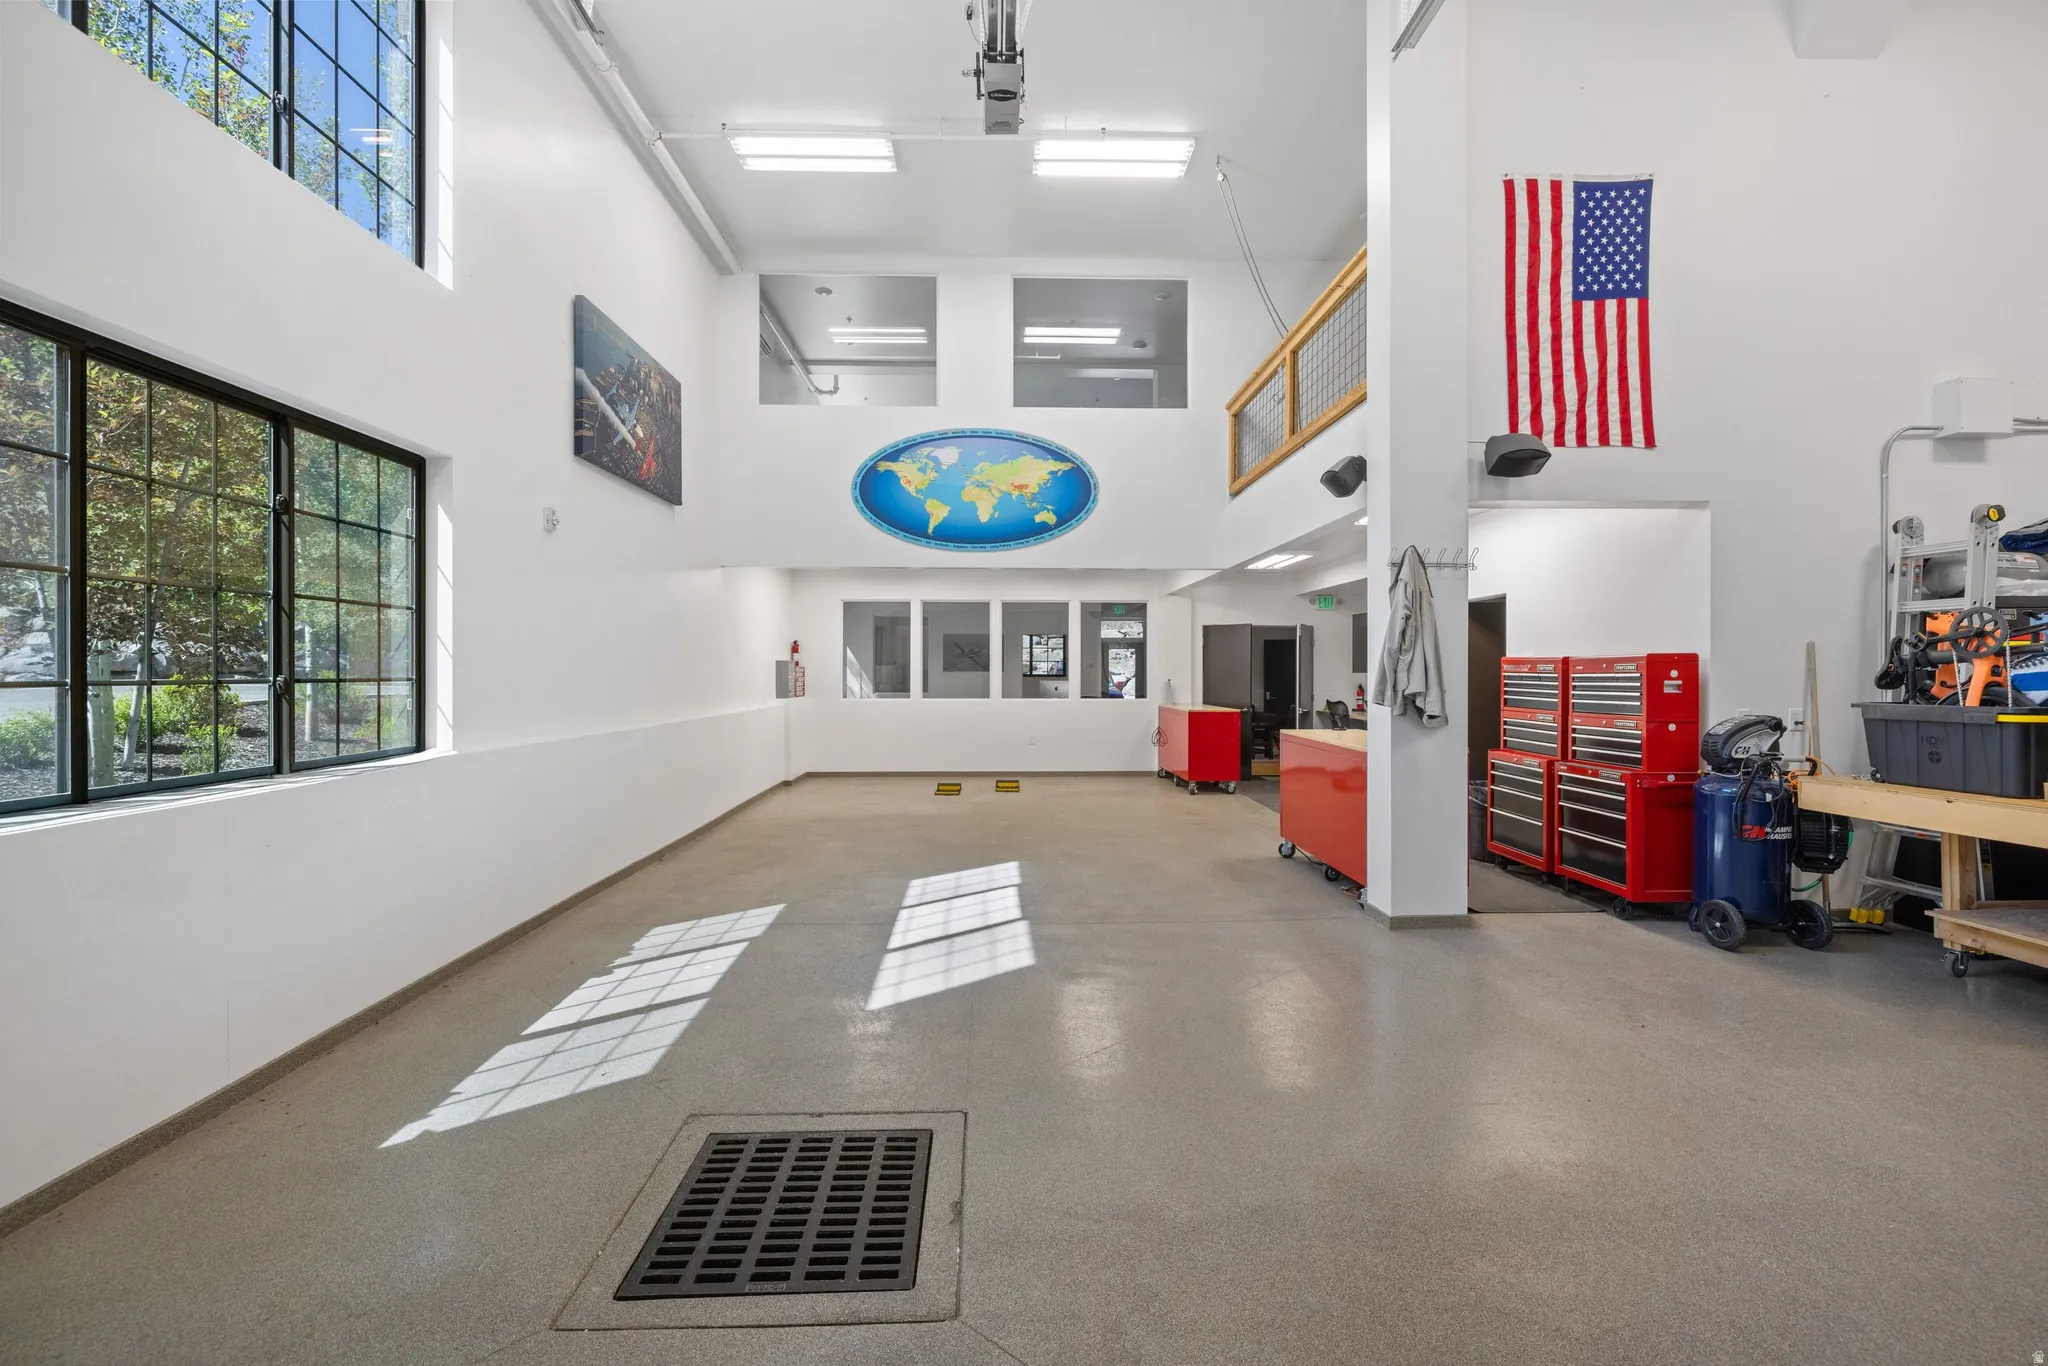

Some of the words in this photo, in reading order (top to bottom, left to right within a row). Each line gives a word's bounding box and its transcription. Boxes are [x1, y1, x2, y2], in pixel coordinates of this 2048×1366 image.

[1318, 595, 1335, 609] EXIT
[1114, 604, 1126, 614] EXIT
[1734, 746, 1751, 756] CH
